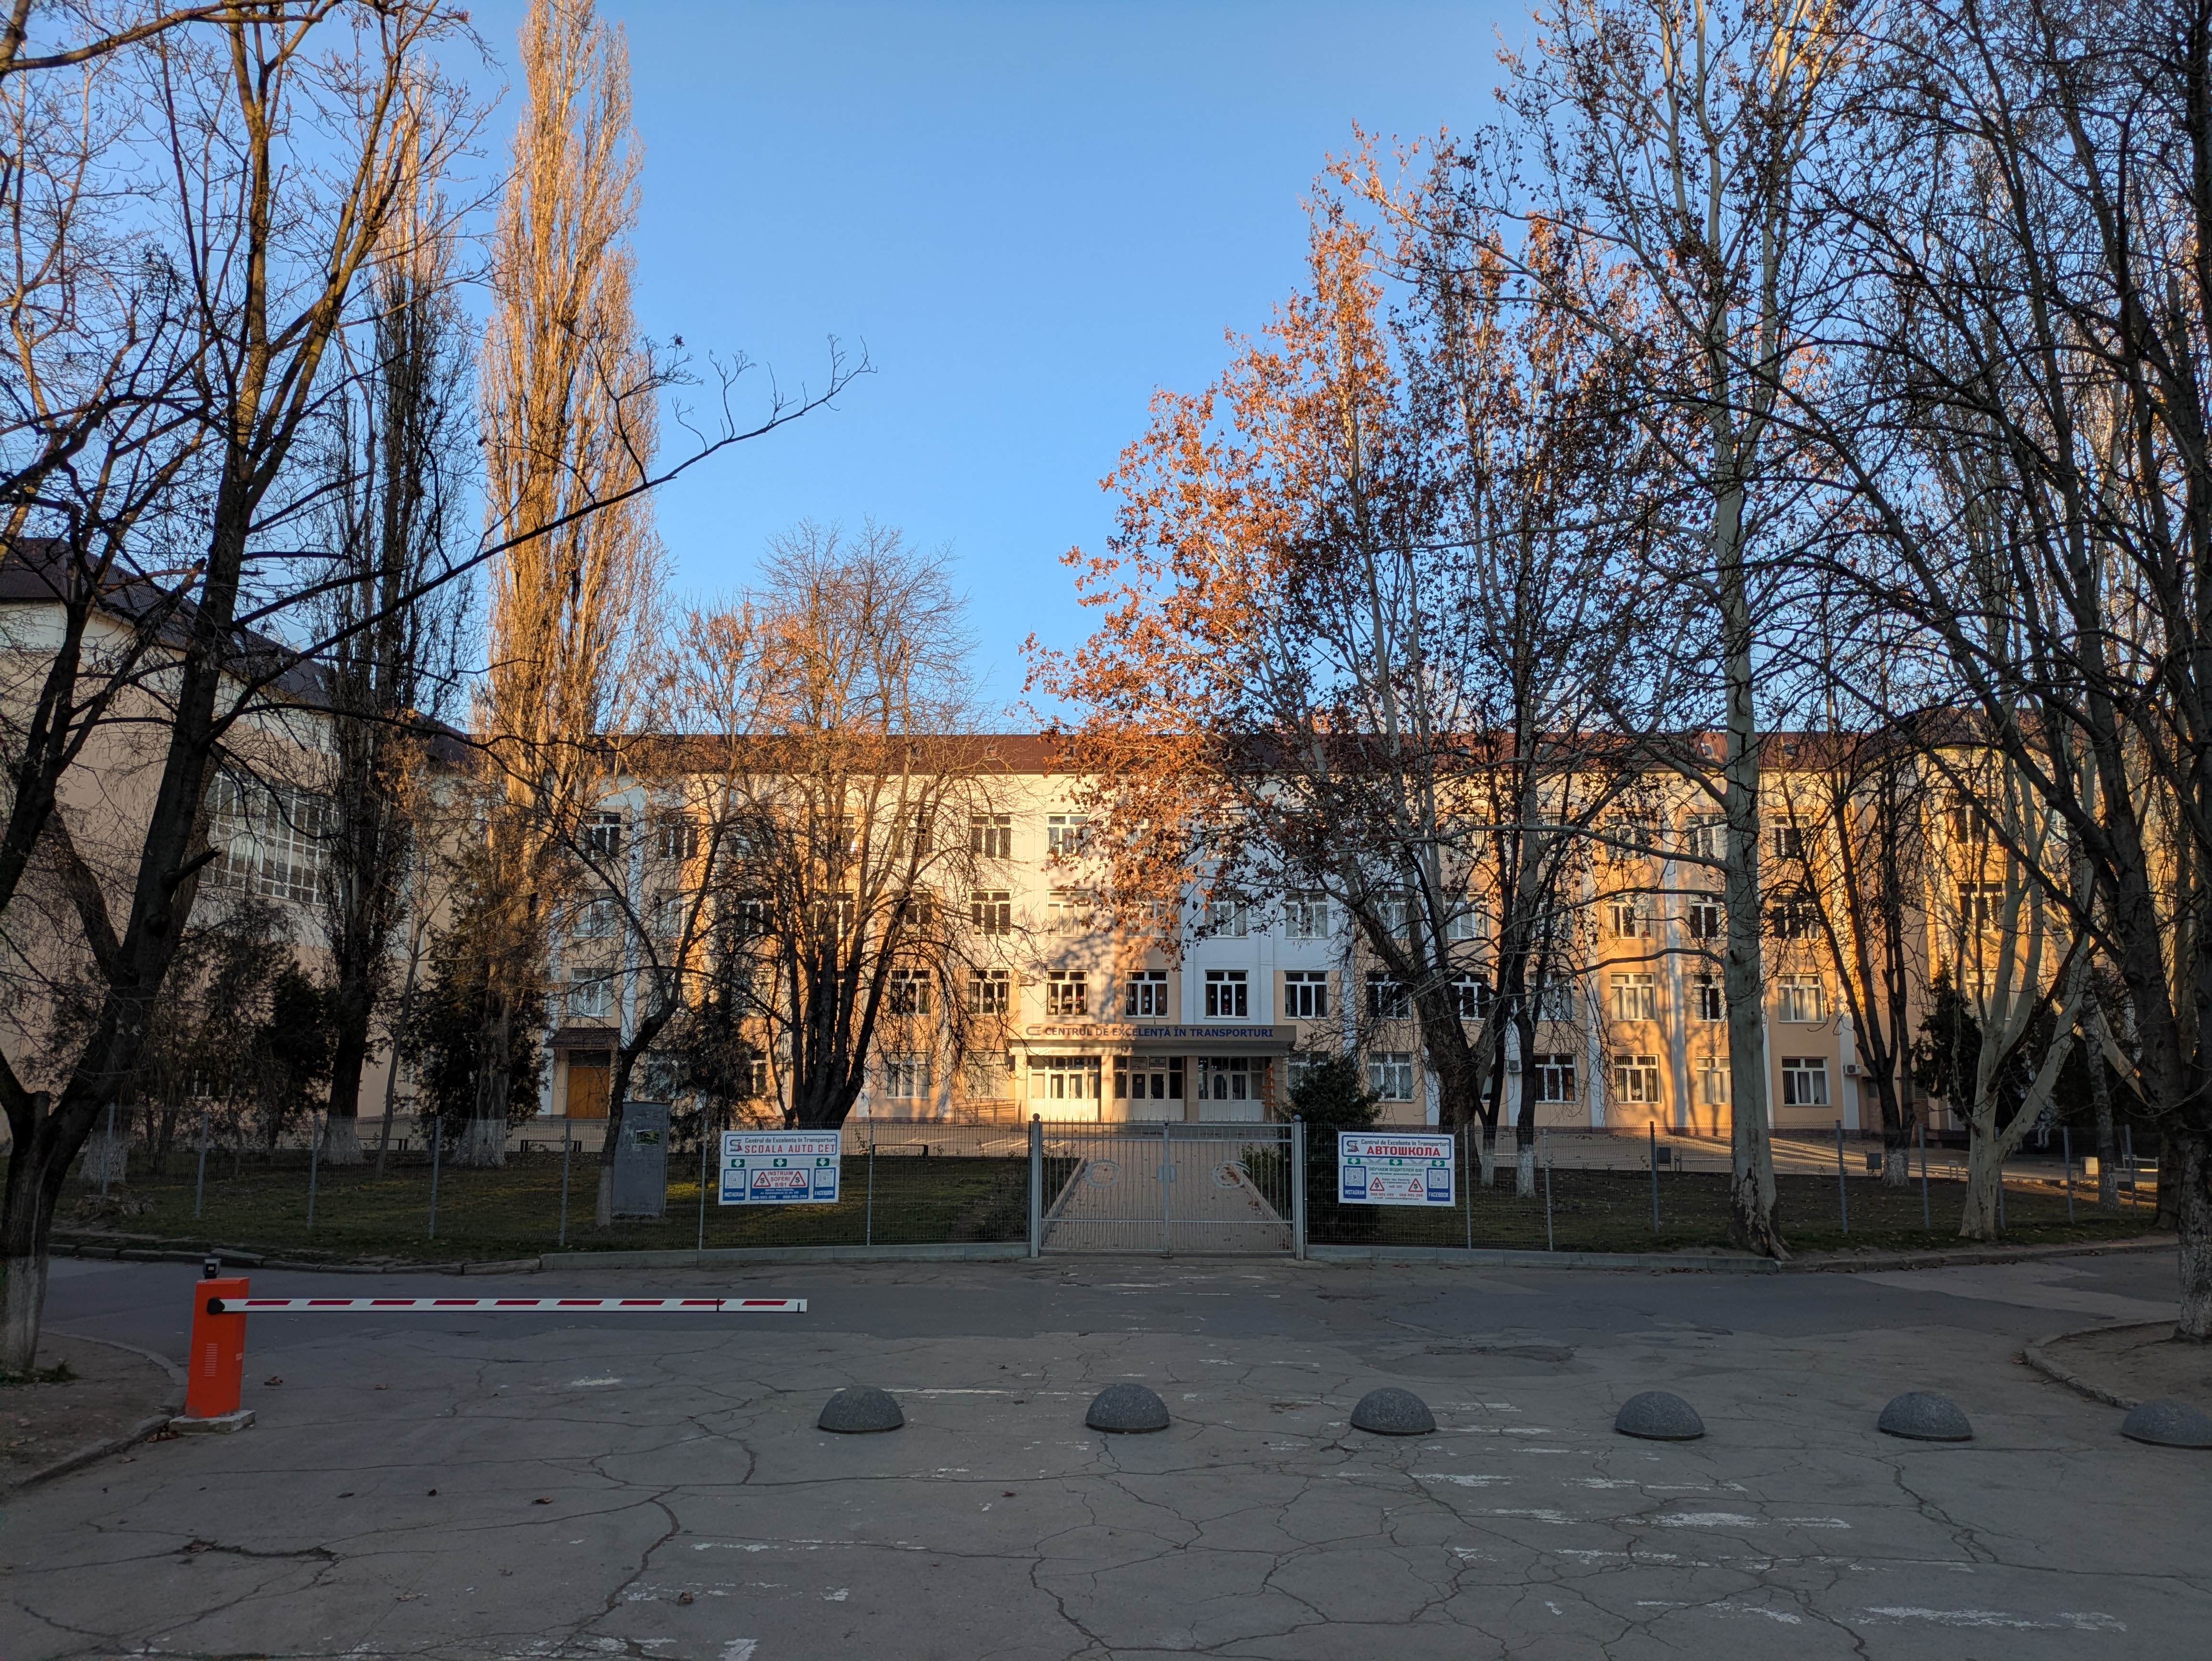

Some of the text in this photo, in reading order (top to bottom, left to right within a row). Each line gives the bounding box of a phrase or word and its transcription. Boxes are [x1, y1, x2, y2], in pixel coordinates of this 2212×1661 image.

[1045, 1028, 1092, 1036] CENTRUL
[1112, 1026, 1171, 1039] EXCELENȚĂ
[1174, 1026, 1186, 1037] ÎN
[1190, 1029, 1273, 1037] TRANSPORTURI
[788, 1144, 813, 1152] AUTO
[818, 1144, 835, 1152] CET
[1367, 1146, 1440, 1156] АВТОШКОЛА
